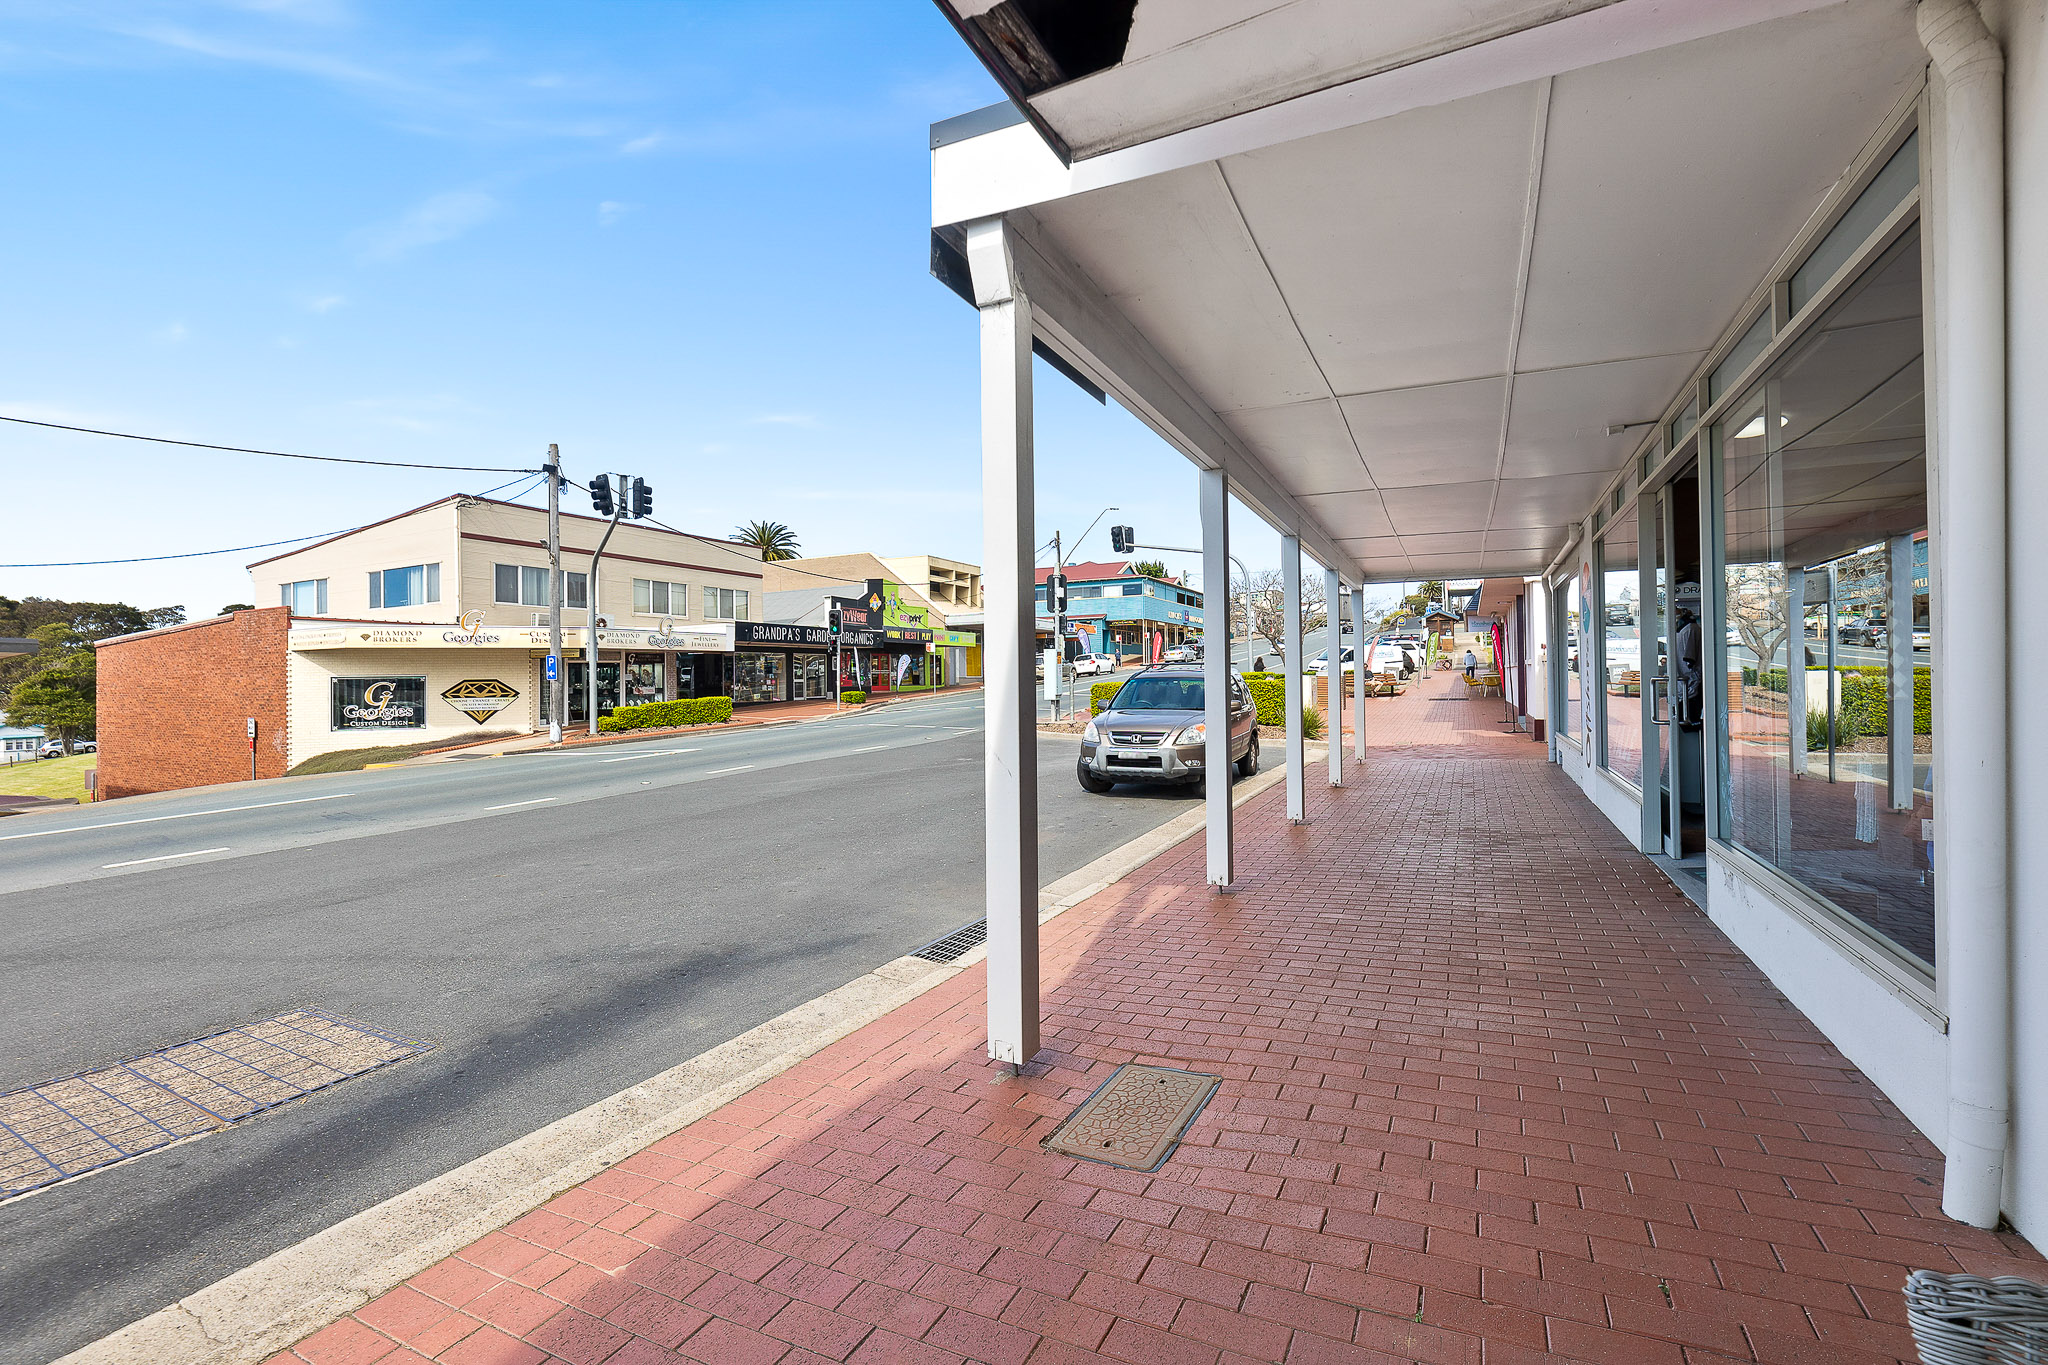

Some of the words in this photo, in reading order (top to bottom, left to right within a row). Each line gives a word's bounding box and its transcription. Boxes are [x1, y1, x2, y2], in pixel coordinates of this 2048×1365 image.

[442, 631, 500, 646] Georgies
[647, 634, 686, 649] Georgies
[752, 625, 801, 641] GRANDPA'S
[806, 628, 837, 643] GARDE
[840, 631, 874, 645] ORGANICS
[548, 657, 555, 667] P
[343, 704, 414, 721] Georgies
